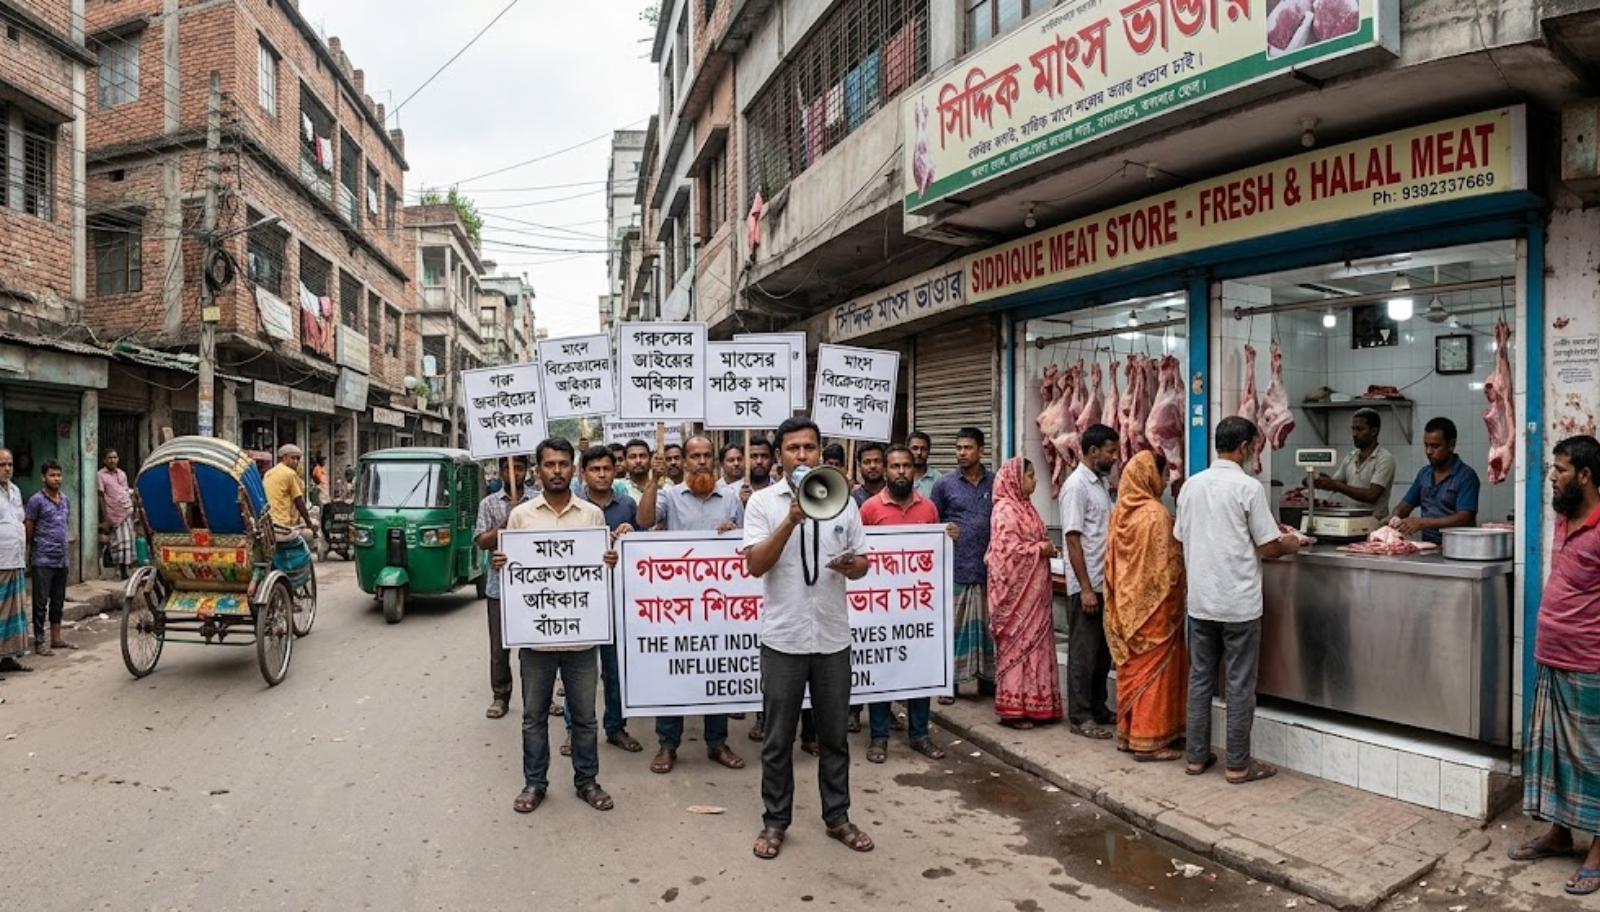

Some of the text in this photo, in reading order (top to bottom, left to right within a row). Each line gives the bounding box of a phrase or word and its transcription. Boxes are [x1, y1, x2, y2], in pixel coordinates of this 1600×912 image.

[937, 63, 1022, 150] সিদ্দিক
[1029, 17, 1111, 100] মাংস
[1373, 172, 1495, 206] Ph: 9392337669
[972, 240, 1044, 293] SIDDIQUE
[1049, 222, 1099, 274] MEAT
[1106, 200, 1178, 258] STORE
[1200, 172, 1274, 227] FRESH
[1284, 167, 1301, 206] &
[1310, 144, 1401, 201] HALAL
[1411, 122, 1495, 179] MEAT
[878, 290, 910, 320] মাংস
[709, 371, 752, 392] সঠিক
[733, 397, 763, 418] চাই
[533, 539, 575, 558] মাংস
[508, 562, 604, 586] বিক্রেতাদের
[636, 547, 750, 584] গভর্নমেন্টে
[635, 579, 935, 625] মাংস শিল্পে ভাব চাই
[533, 614, 581, 636] বাঁচান
[637, 622, 935, 654] THE MEAT INDU RVES MORE
[668, 645, 908, 675] INFLUENCE MENT'S
[851, 669, 876, 687] ON.
